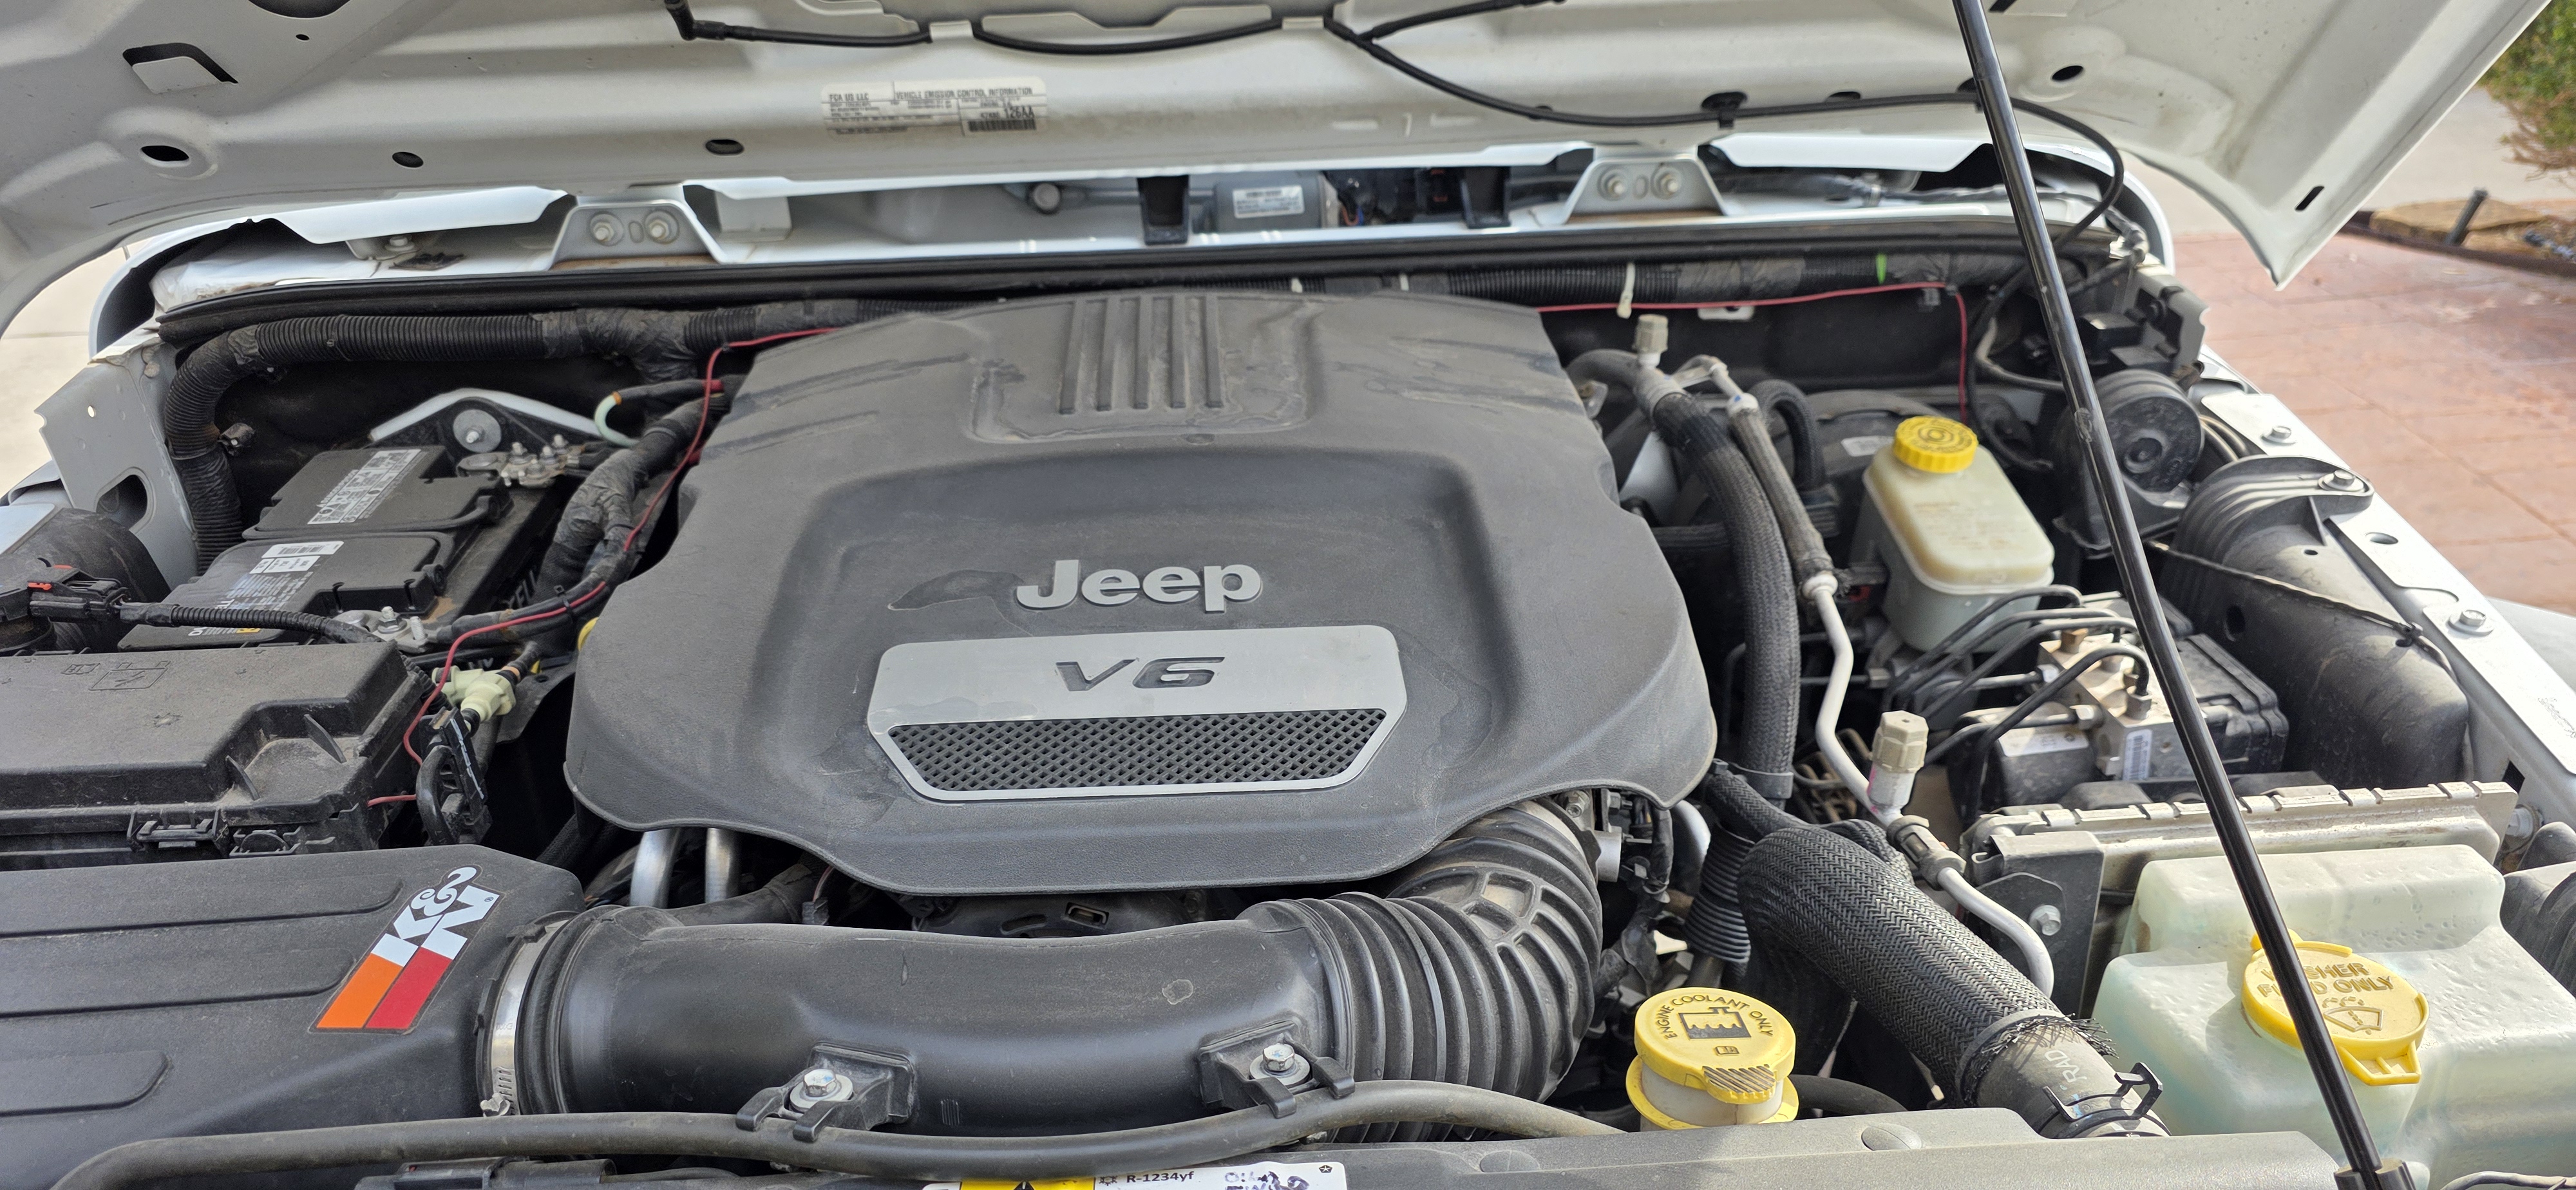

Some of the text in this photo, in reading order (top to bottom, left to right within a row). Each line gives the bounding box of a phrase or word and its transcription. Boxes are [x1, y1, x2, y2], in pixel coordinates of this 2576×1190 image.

[925, 90, 954, 99] EMISSION
[989, 88, 1033, 96] INFORMATION
[1016, 558, 1262, 614] Jeep
[1055, 656, 1225, 692] V6
[2333, 976, 2394, 994] ONLY
[1655, 994, 1775, 1040] ENGINE COOLANT ONLY
[2044, 1049, 2088, 1084] RAD
[1126, 1171, 1195, 1184] R-1234yf
